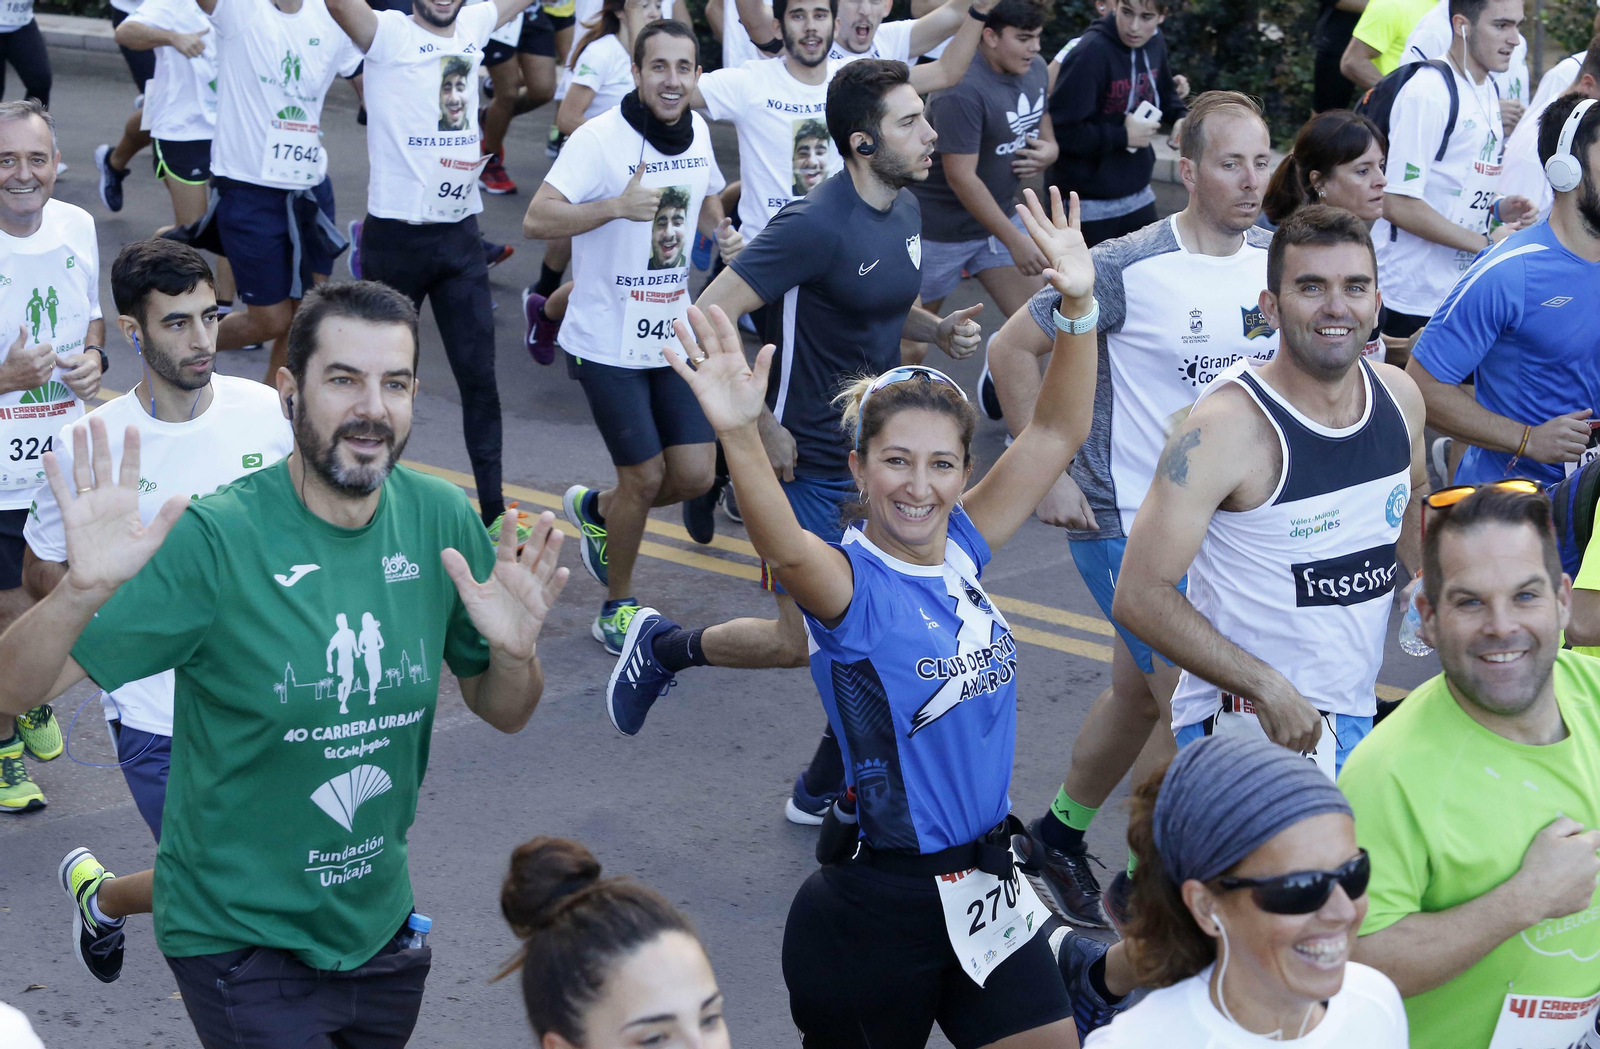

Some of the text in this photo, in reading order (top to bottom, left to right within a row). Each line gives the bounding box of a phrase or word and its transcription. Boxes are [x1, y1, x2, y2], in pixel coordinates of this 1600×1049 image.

[419, 43, 433, 53] NO
[767, 99, 782, 109] NO
[784, 105, 811, 113] ESTA
[408, 136, 436, 146] ESTA
[439, 138, 453, 146] DE
[272, 143, 319, 163] 17642
[440, 158, 452, 167] 41
[645, 161, 669, 173] ESTA
[671, 157, 708, 169] MUERTO
[1474, 162, 1485, 174] 41
[616, 275, 644, 287] ESTA
[631, 290, 644, 301] 41
[13, 404, 50, 413] CARRERA
[52, 401, 76, 411] URBANA
[1290, 509, 1340, 526] Vélez-Málaga
[1289, 519, 1340, 539] deportes
[382, 555, 419, 577] 2020
[916, 655, 967, 680] CLUB
[283, 728, 308, 742] 40
[312, 718, 377, 741] CARRERA
[324, 737, 390, 759] El Corte Inglés
[308, 835, 384, 864] Fundación
[320, 860, 372, 887] Unicaja
[1536, 926, 1554, 941] LA
[1510, 999, 1537, 1018] 41
[1539, 1011, 1577, 1019] CIUDAD
